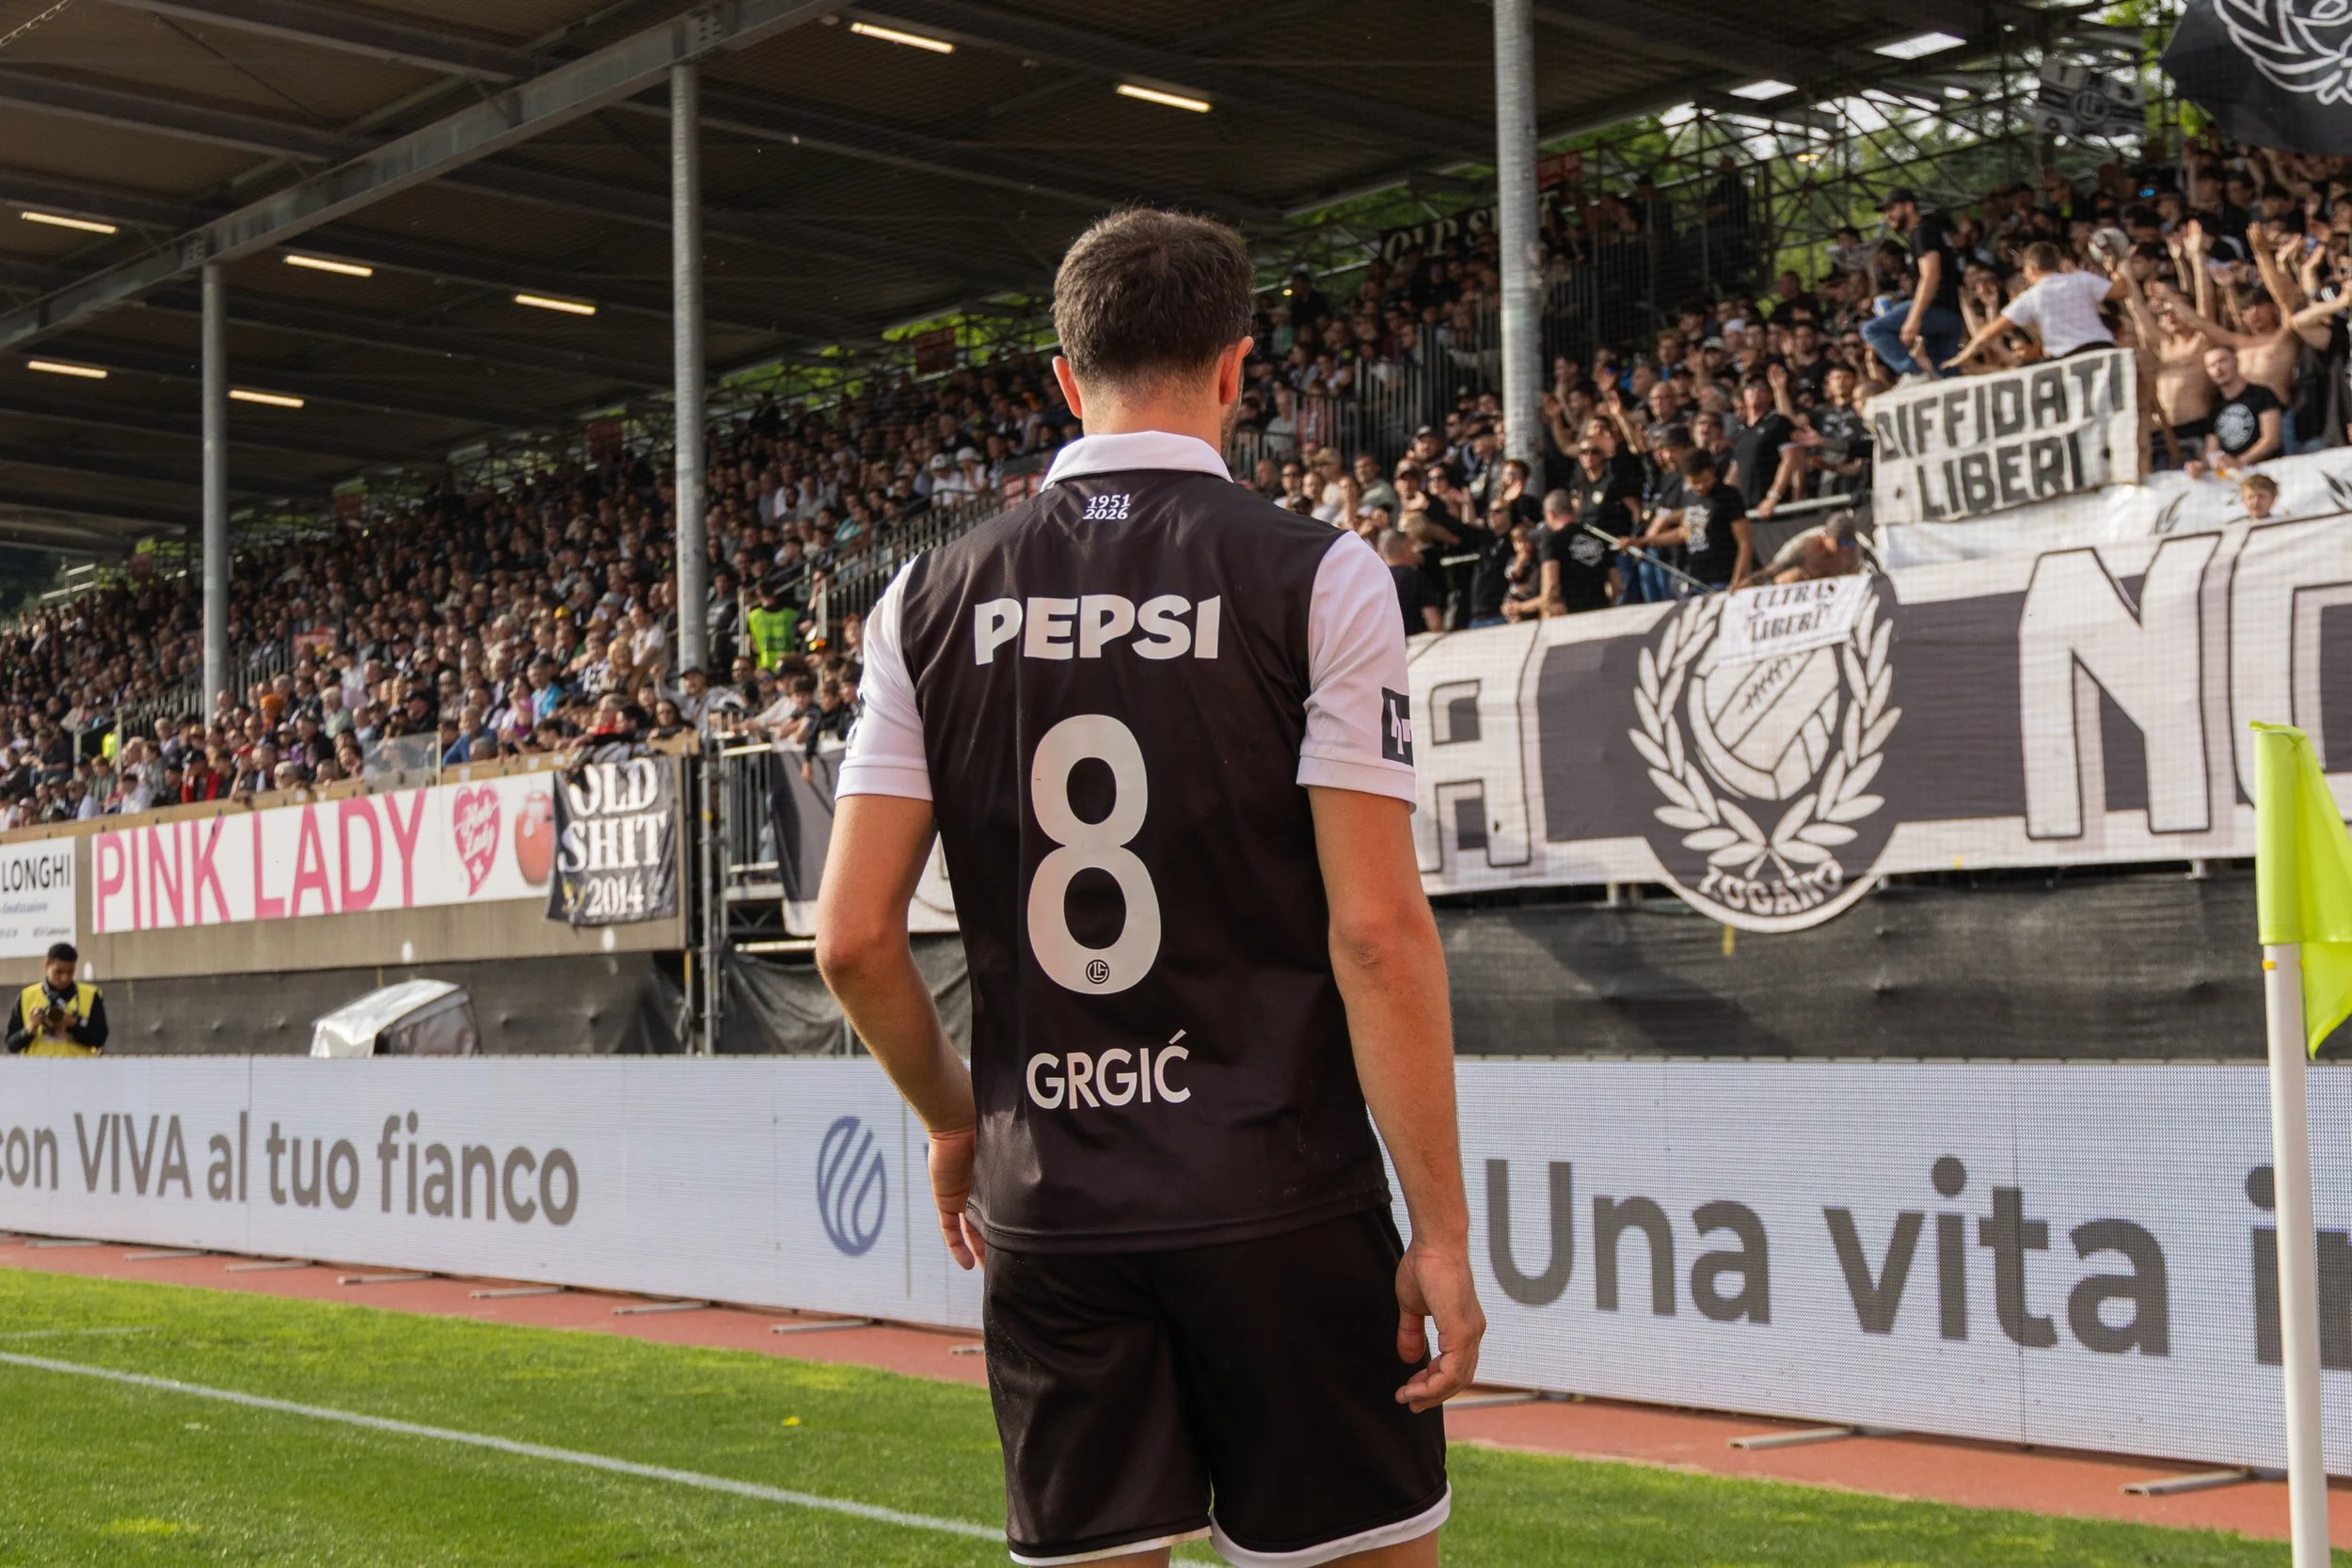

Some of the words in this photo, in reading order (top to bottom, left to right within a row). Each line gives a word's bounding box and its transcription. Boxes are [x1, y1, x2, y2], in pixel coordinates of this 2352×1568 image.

[1087, 494, 1131, 509] 1951
[1916, 431, 2084, 519] LIBERI
[1082, 506, 1128, 520] 2026
[975, 594, 1221, 665] PEPSI
[568, 757, 659, 816] OLD
[2, 853, 71, 893] LONGHI
[97, 815, 230, 933] PINK
[253, 787, 427, 920] LADY
[557, 811, 668, 873] SHIT
[1027, 714, 1162, 995] 8
[585, 871, 645, 918] 2014
[1026, 1029, 1191, 1110] GRGIĆ
[0, 1125, 58, 1191] on
[73, 1112, 192, 1199] VIVA
[208, 1110, 248, 1203] al
[265, 1121, 359, 1210] tuo
[377, 1110, 580, 1227] fianco
[1485, 1158, 1772, 1325] Una
[1821, 1153, 2171, 1358] vita
